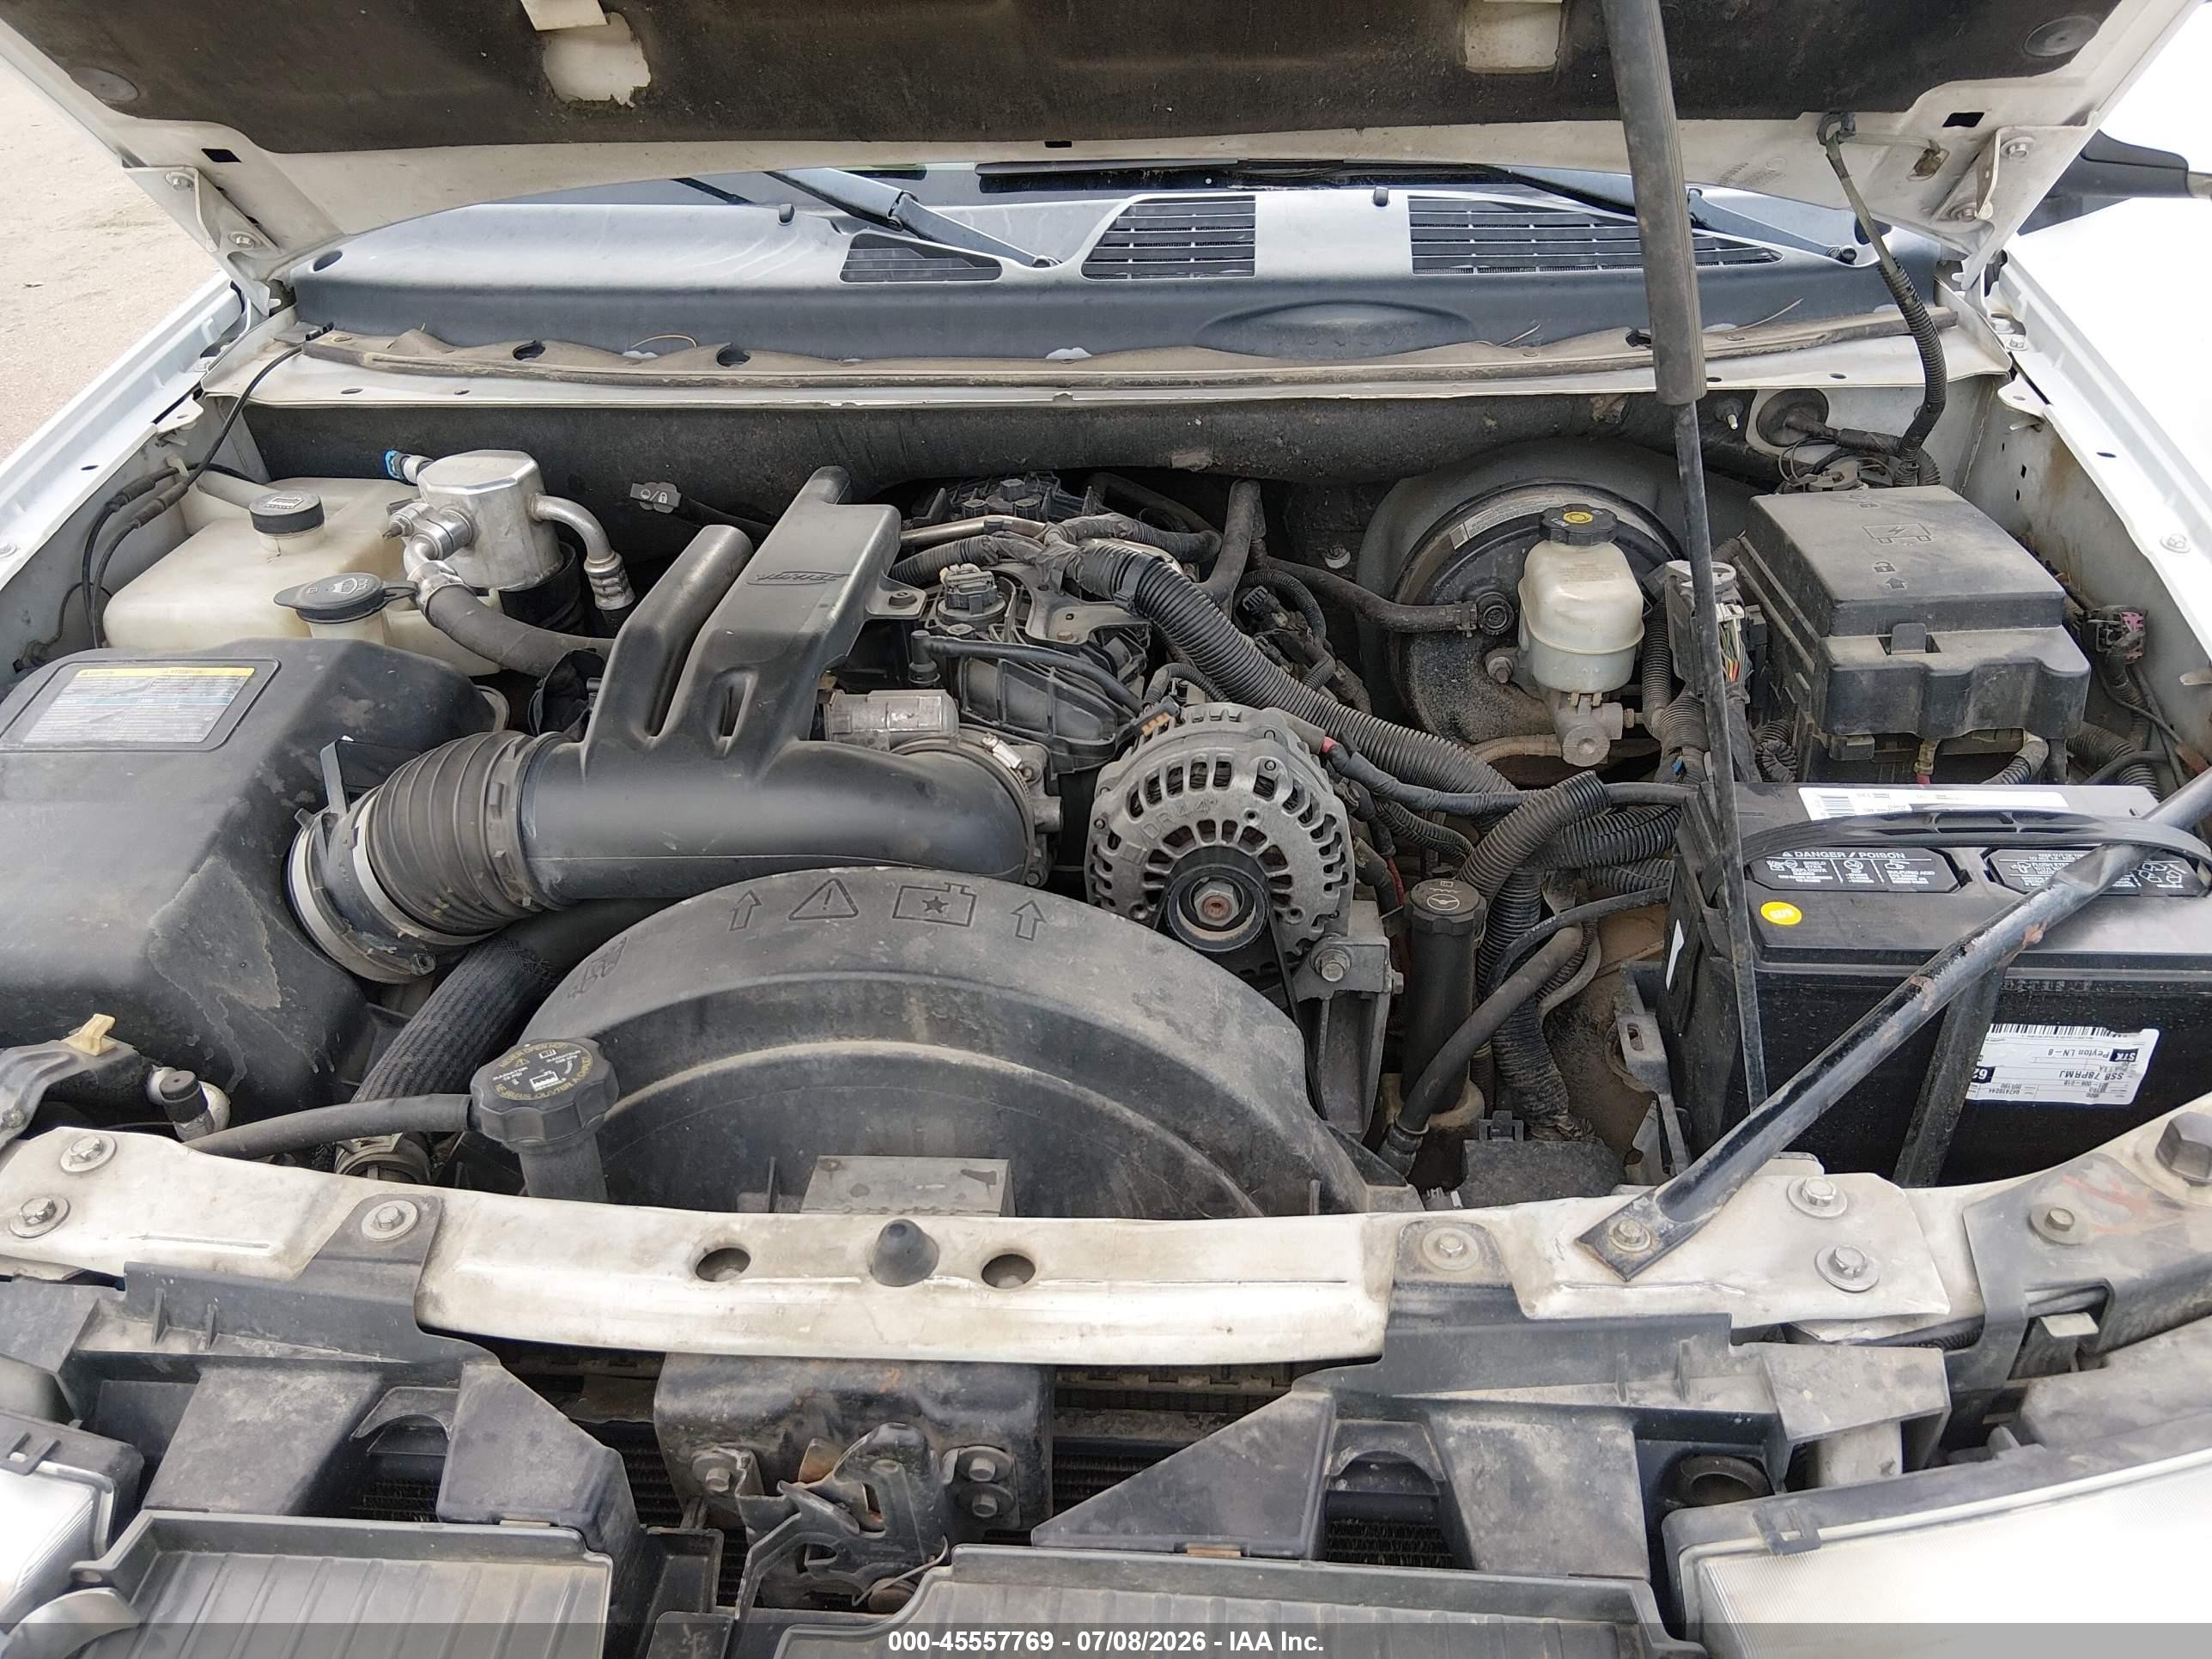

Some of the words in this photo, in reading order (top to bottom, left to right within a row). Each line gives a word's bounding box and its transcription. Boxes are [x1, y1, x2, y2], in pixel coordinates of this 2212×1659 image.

[2078, 1048, 2110, 1059] Peyton
[2115, 1052, 2136, 1061] STK
[2059, 1070, 2100, 1079] 78PRMJ
